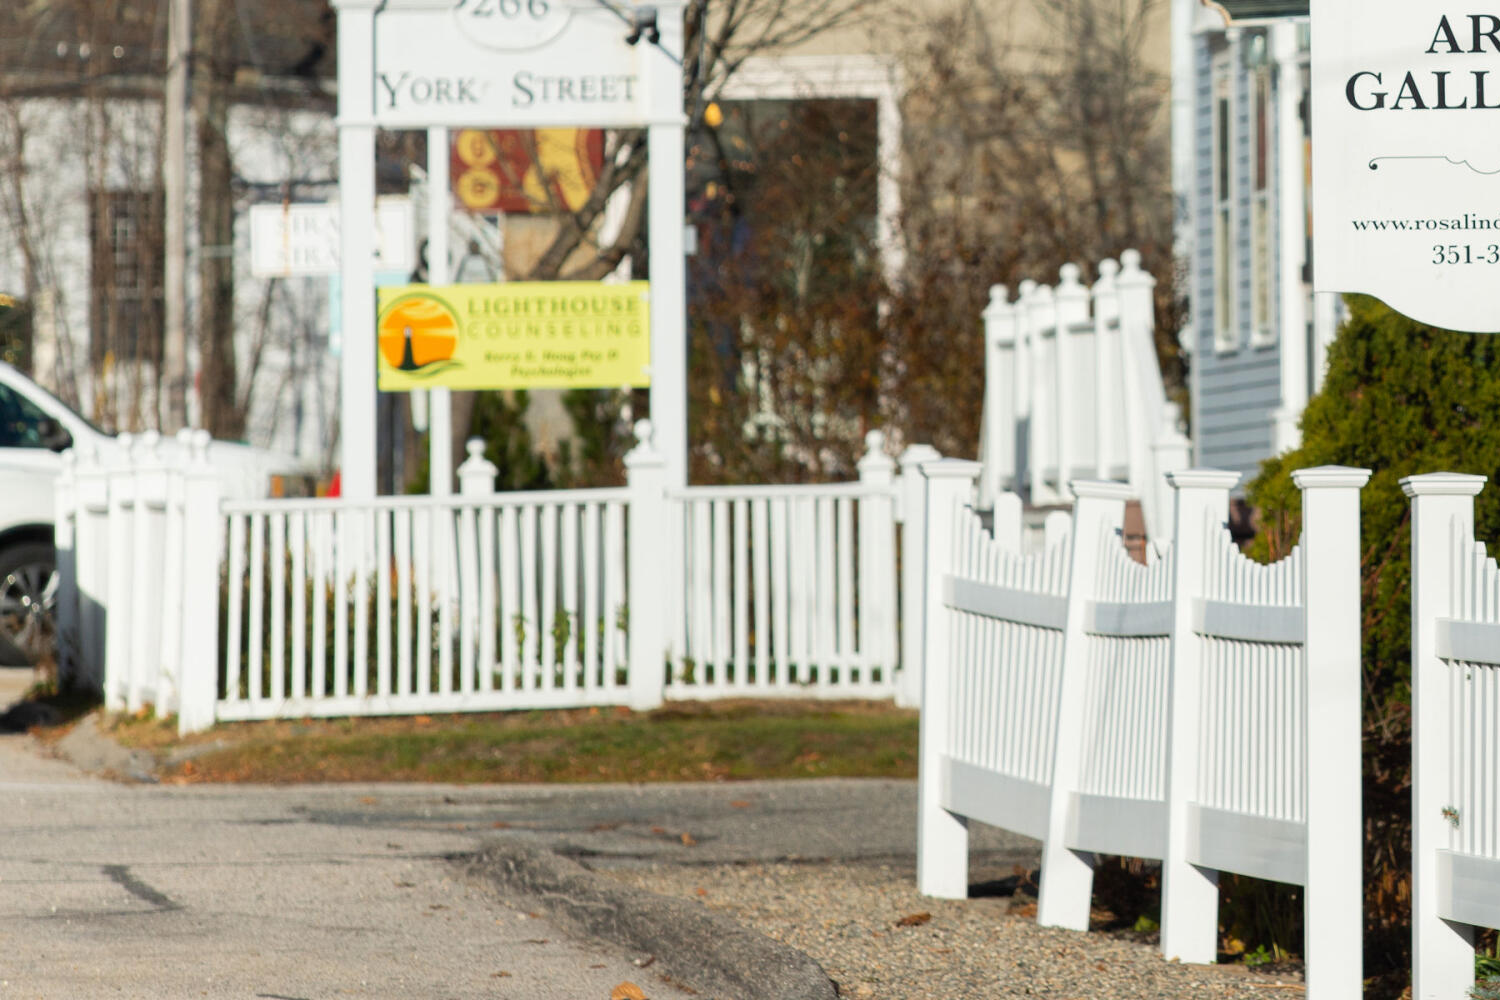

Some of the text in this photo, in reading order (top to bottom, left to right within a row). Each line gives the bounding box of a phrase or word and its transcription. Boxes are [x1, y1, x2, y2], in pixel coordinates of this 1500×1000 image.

[377, 70, 639, 109] YORK STREET
[467, 295, 639, 316] LIGHTHOUSE
[467, 320, 641, 339] COUNSELING
